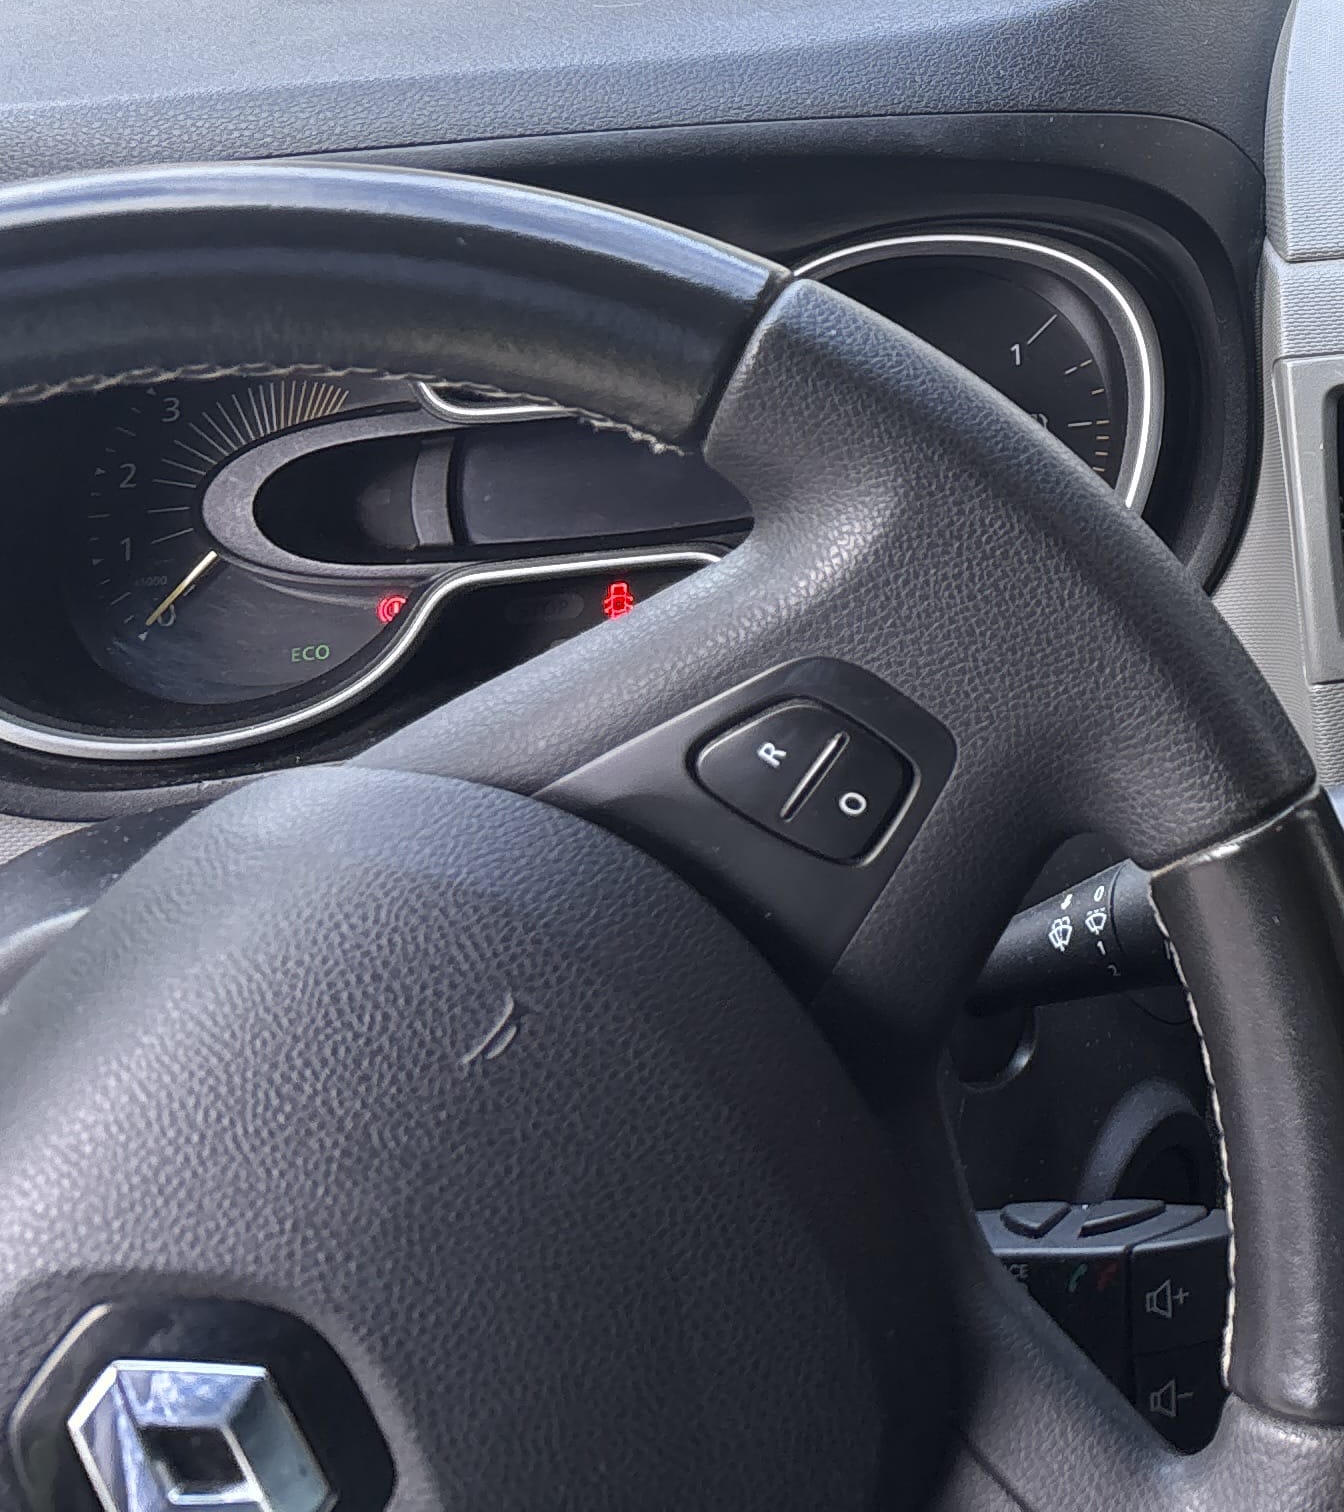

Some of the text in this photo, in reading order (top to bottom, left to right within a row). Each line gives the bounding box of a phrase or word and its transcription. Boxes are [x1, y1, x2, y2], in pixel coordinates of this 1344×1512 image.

[1010, 343, 1021, 366] 1
[161, 396, 181, 423] 3
[119, 462, 138, 489] 2
[121, 537, 132, 561] 1
[156, 604, 177, 627] 0
[291, 644, 331, 663] ECO
[756, 741, 788, 769] R
[1096, 940, 1107, 956] 1
[1107, 963, 1121, 977] 2
